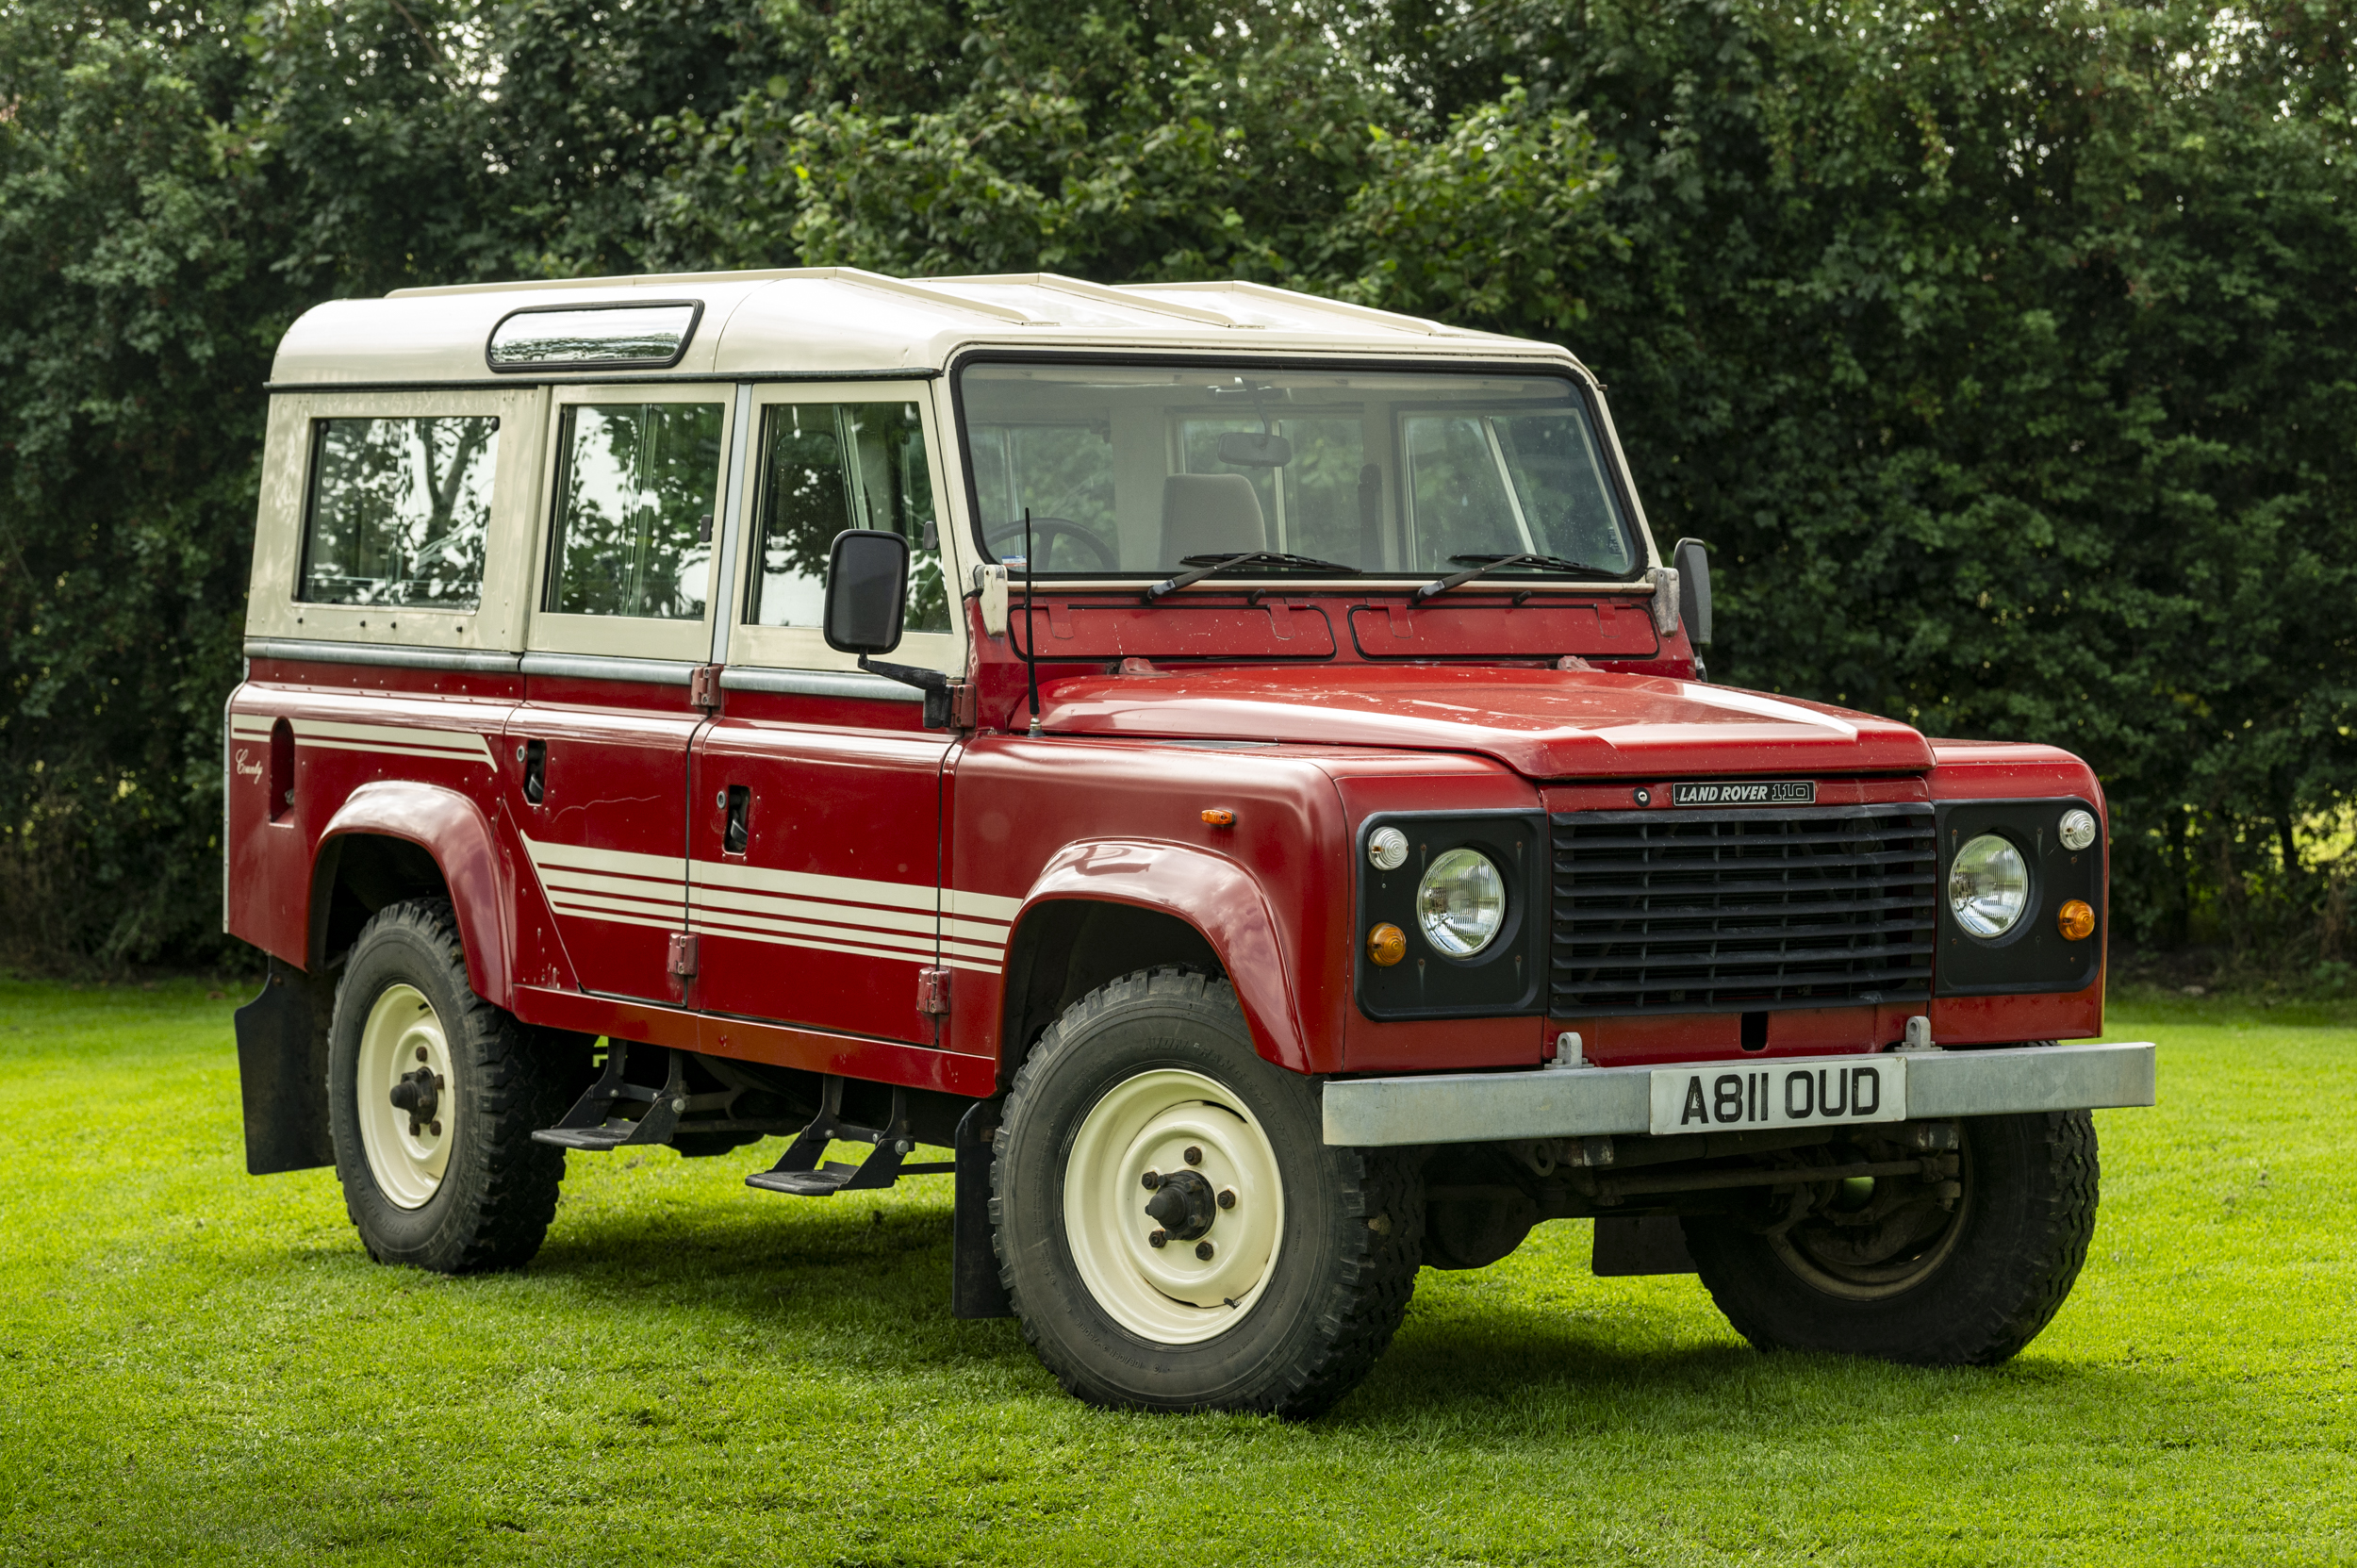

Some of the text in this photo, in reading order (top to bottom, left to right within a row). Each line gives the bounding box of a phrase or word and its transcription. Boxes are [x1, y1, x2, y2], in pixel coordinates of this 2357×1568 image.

[1679, 783, 1810, 802] LAND ROVER 110
[1680, 1066, 1880, 1126] A811 OUD
